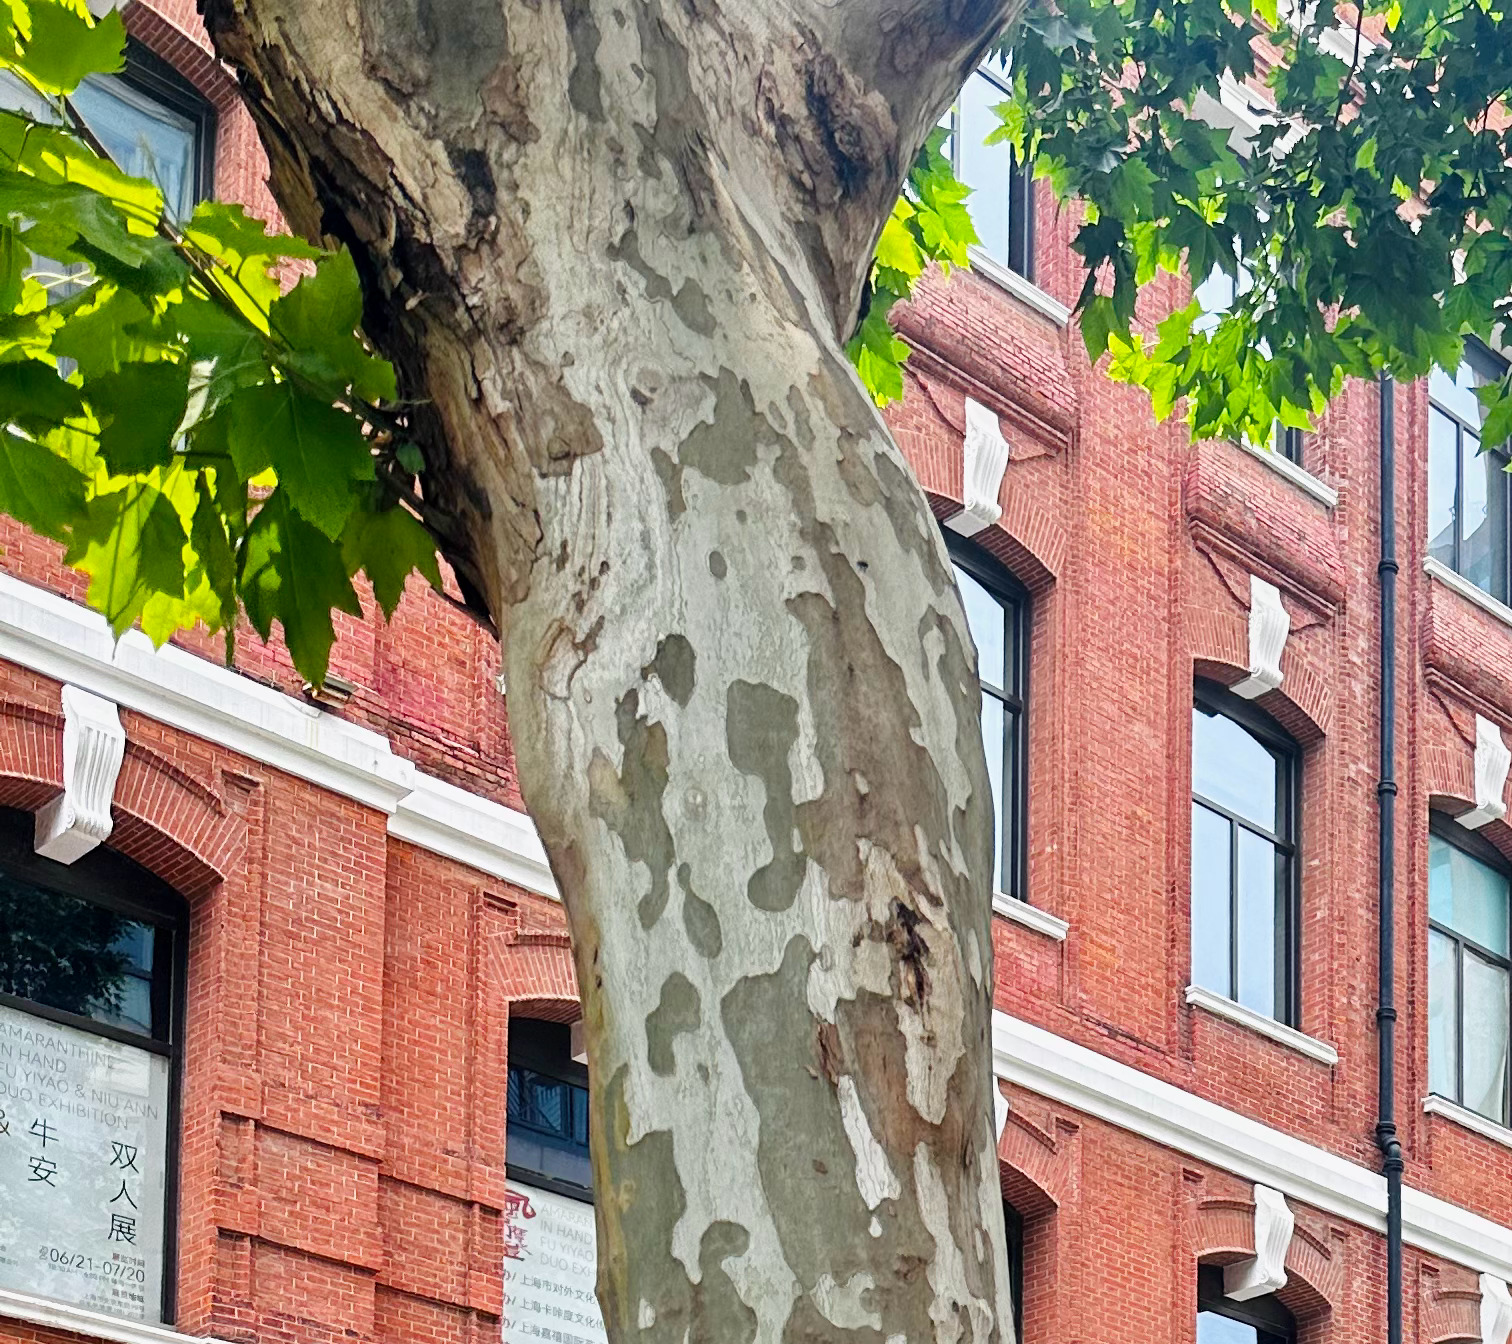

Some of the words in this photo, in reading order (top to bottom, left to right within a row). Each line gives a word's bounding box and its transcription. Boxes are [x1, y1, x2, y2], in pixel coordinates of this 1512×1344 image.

[1, 1042, 13, 1058] N
[19, 1048, 67, 1074] HAND
[22, 1066, 69, 1094] YIYAO
[91, 1088, 120, 1108] NIU
[123, 1098, 159, 1121] ANN
[38, 1092, 130, 1131] EXHIBITION
[28, 1117, 60, 1188] 牛安
[107, 1140, 140, 1246] 双人展
[540, 1220, 554, 1235] IN
[556, 1226, 594, 1246] HAND
